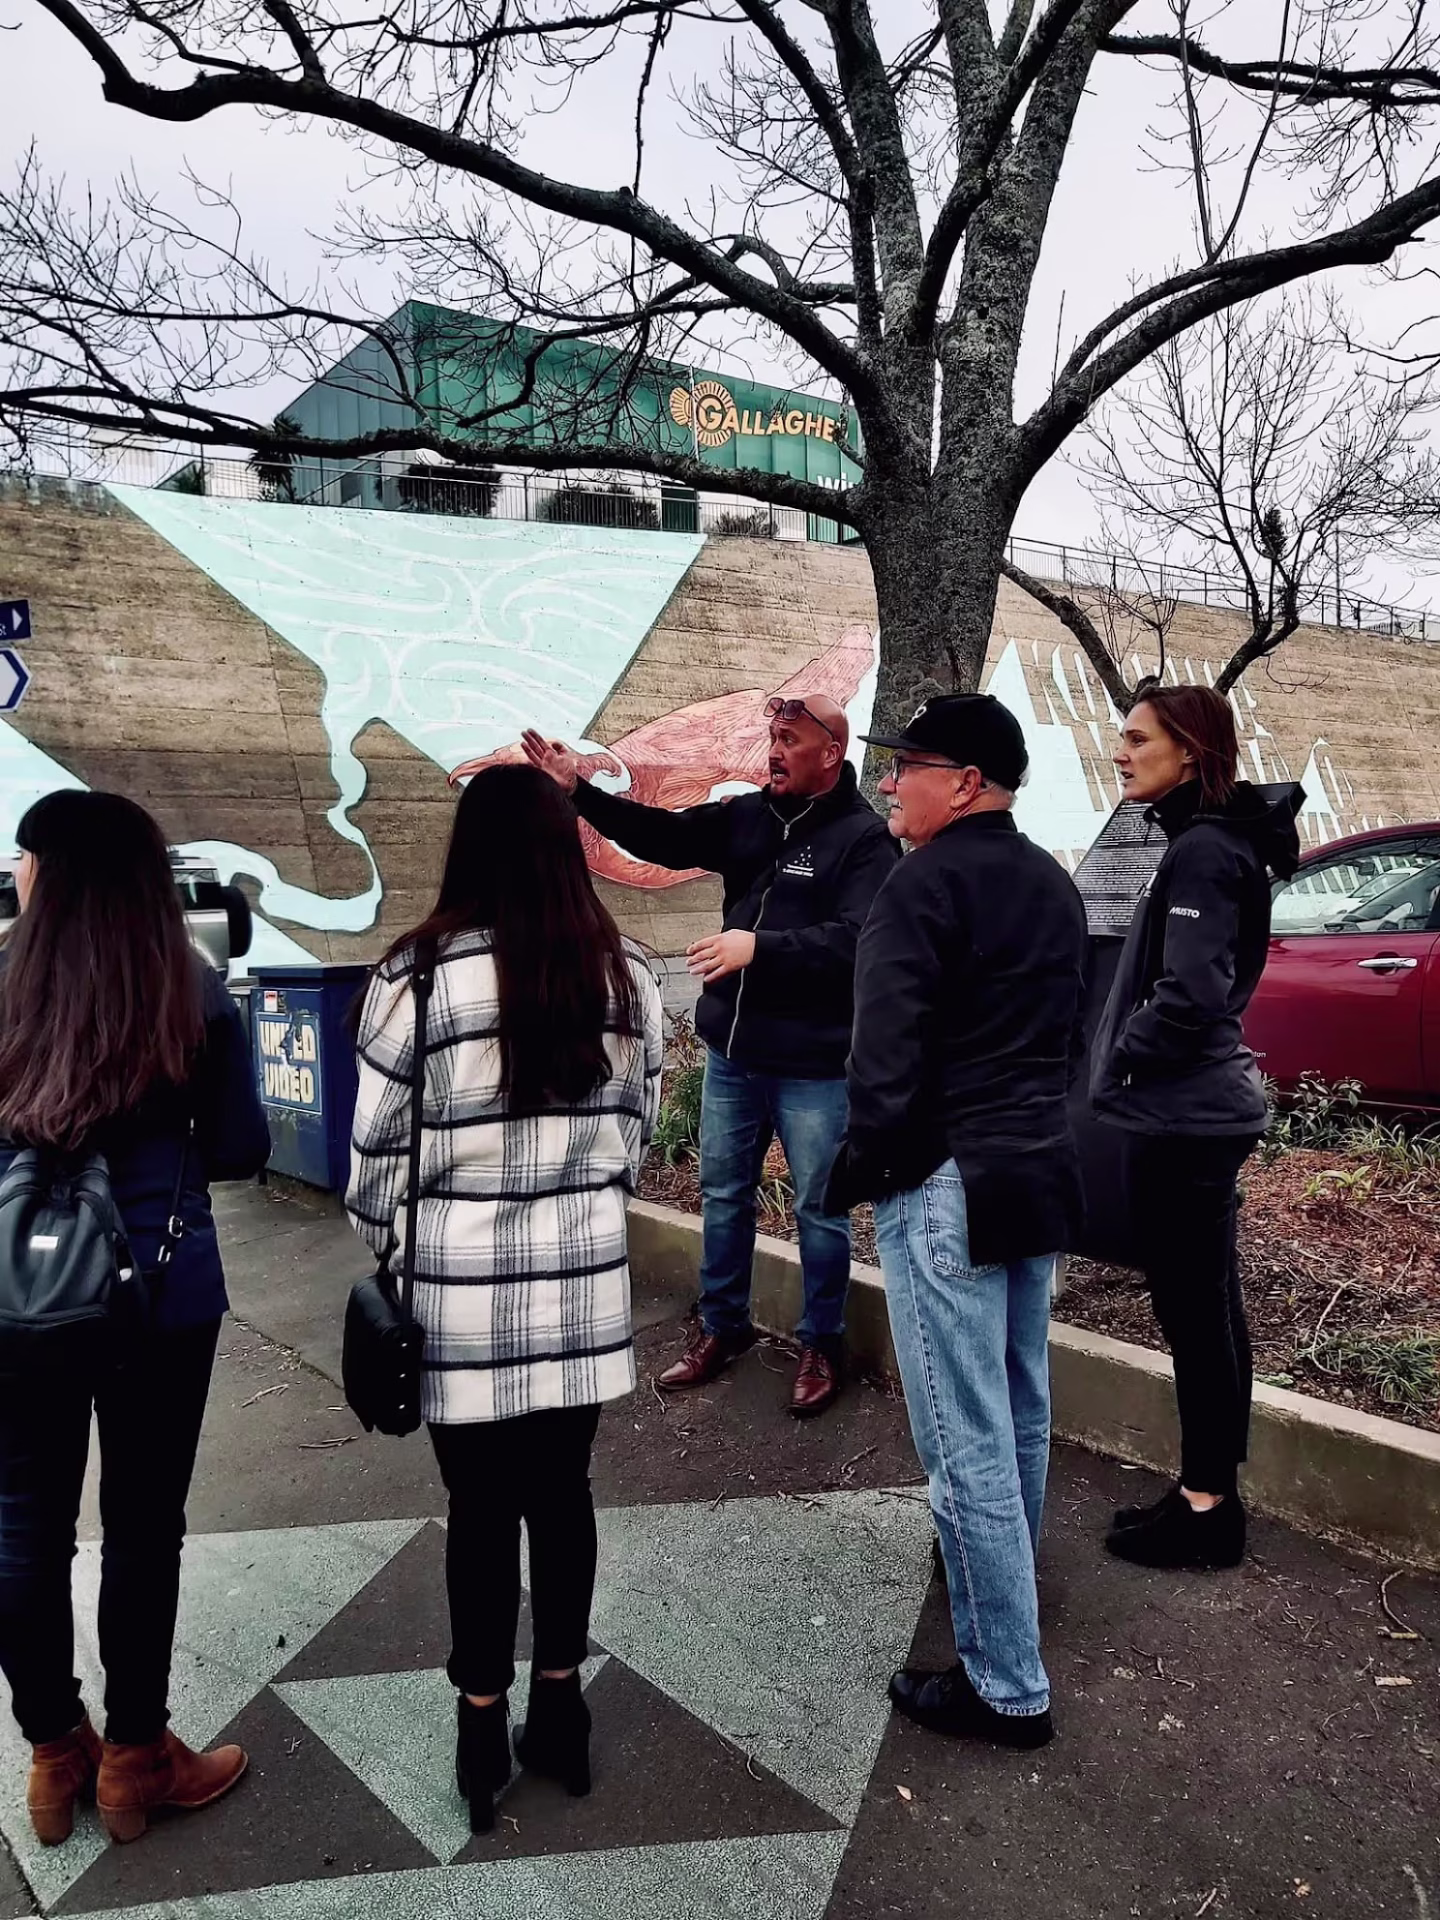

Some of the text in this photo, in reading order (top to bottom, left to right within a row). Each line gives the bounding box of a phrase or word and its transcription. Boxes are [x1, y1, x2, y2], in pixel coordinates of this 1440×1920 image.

[699, 398, 837, 443] GALLAGHE
[1169, 906, 1200, 918] MUSTO
[260, 1021, 316, 1061] UNIED
[264, 1063, 314, 1103] VIDEO
